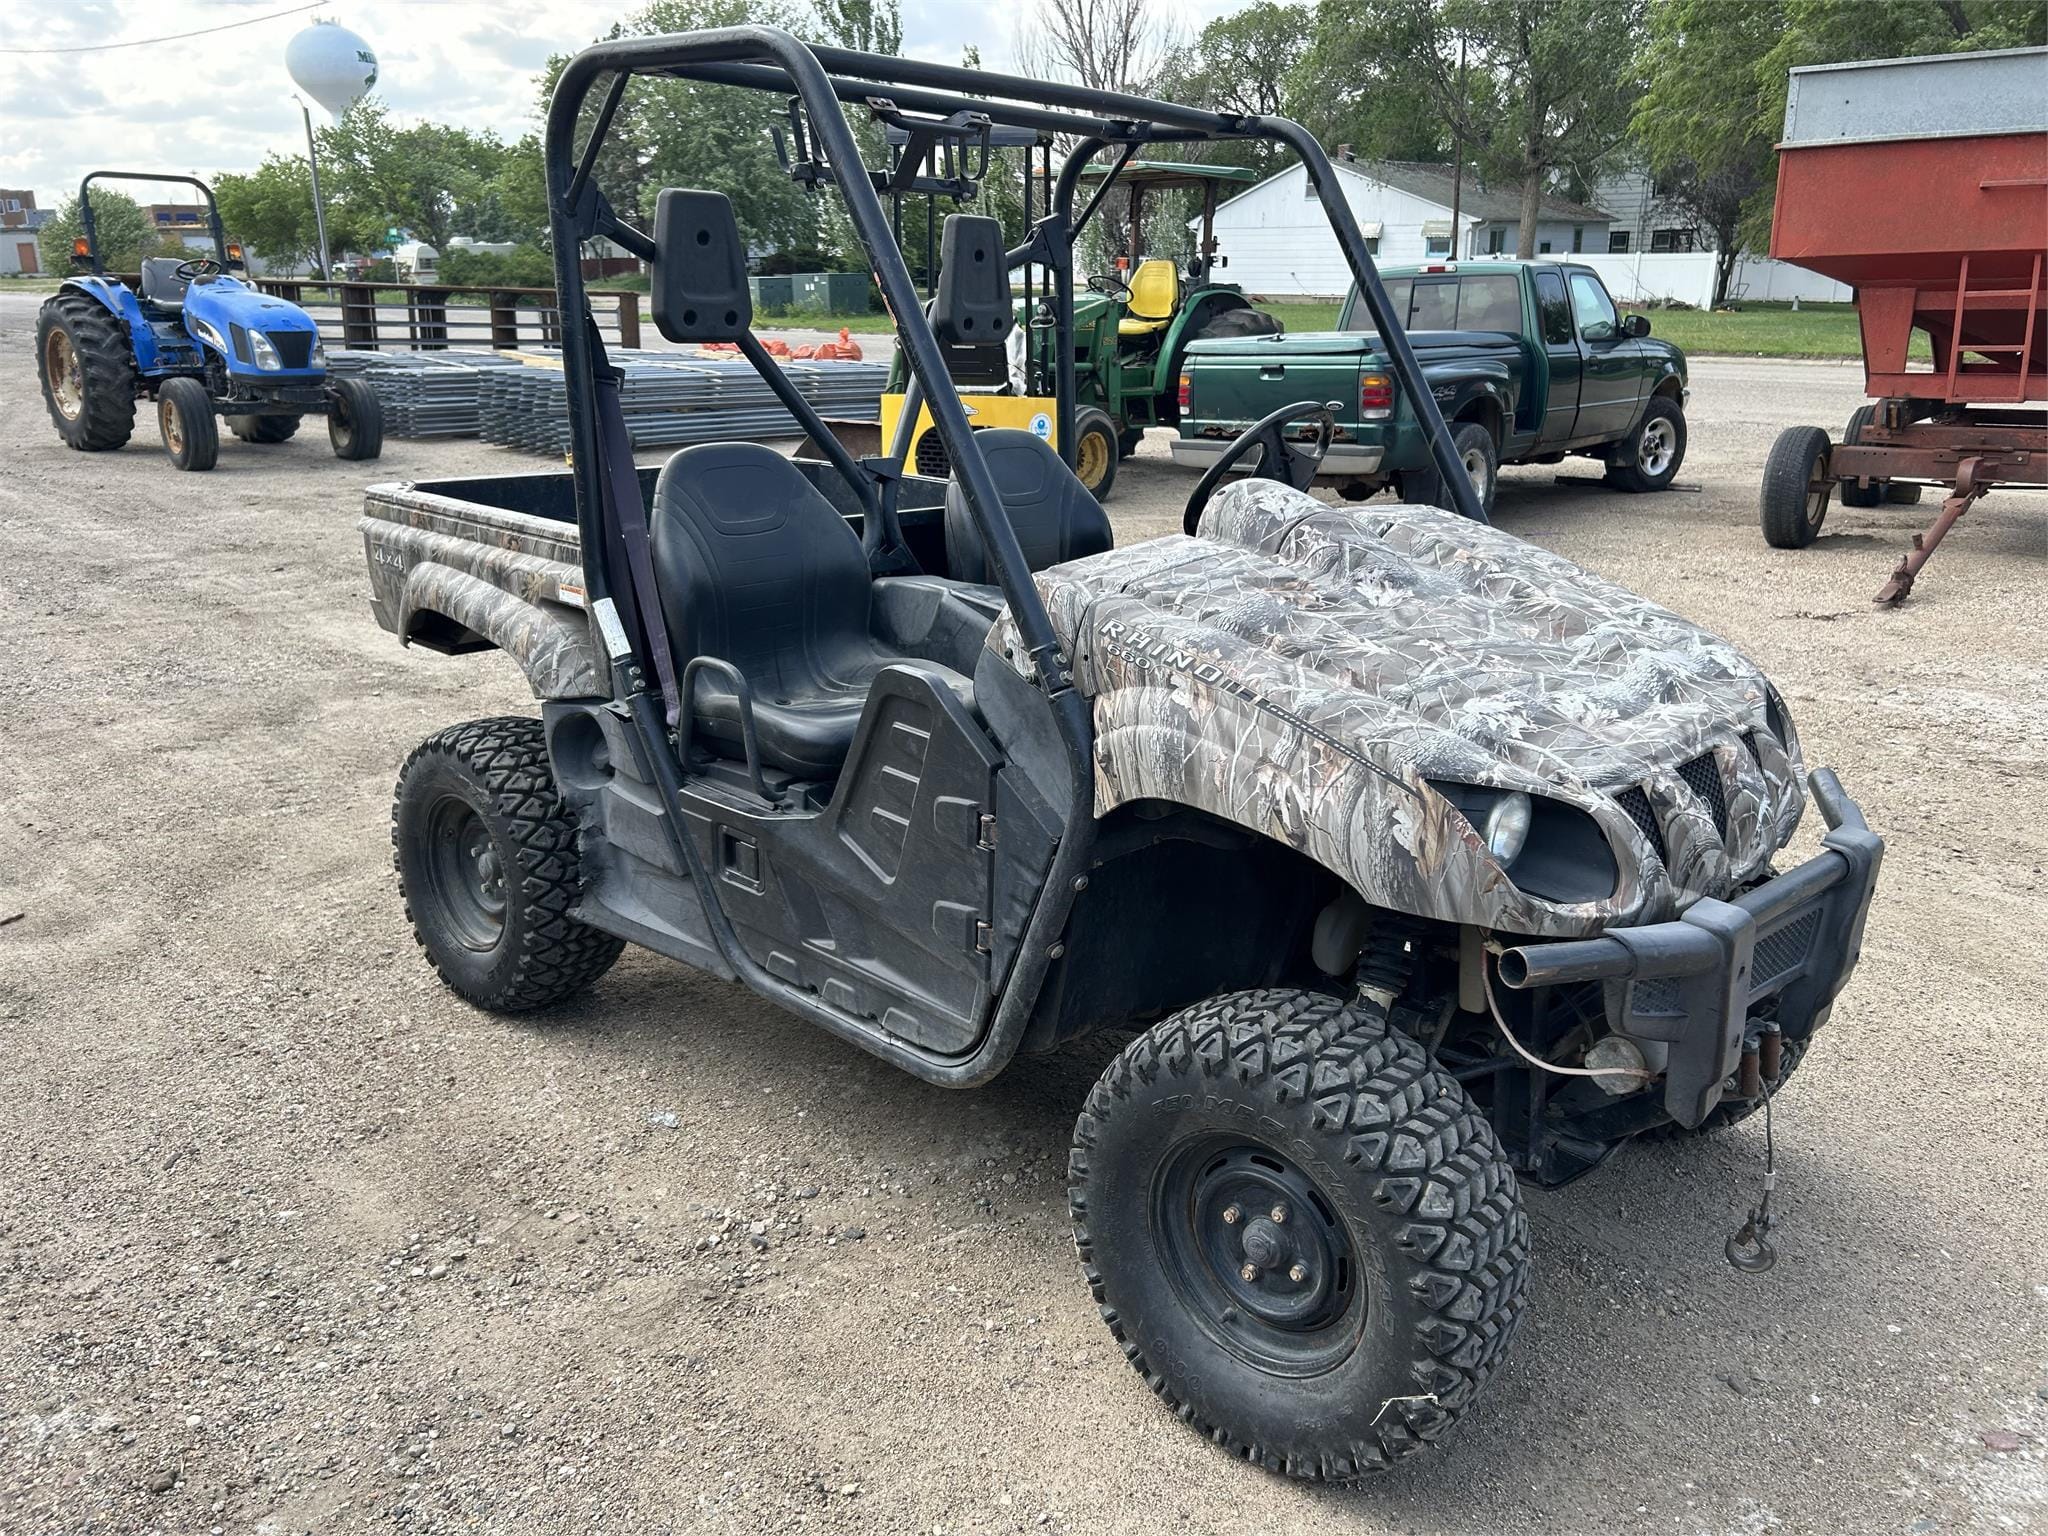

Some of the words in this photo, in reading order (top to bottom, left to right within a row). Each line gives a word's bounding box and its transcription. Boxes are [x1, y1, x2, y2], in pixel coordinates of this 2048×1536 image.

[375, 548, 404, 570] 4x4
[1098, 618, 1224, 685] RHINO
[1106, 642, 1151, 669] 660
